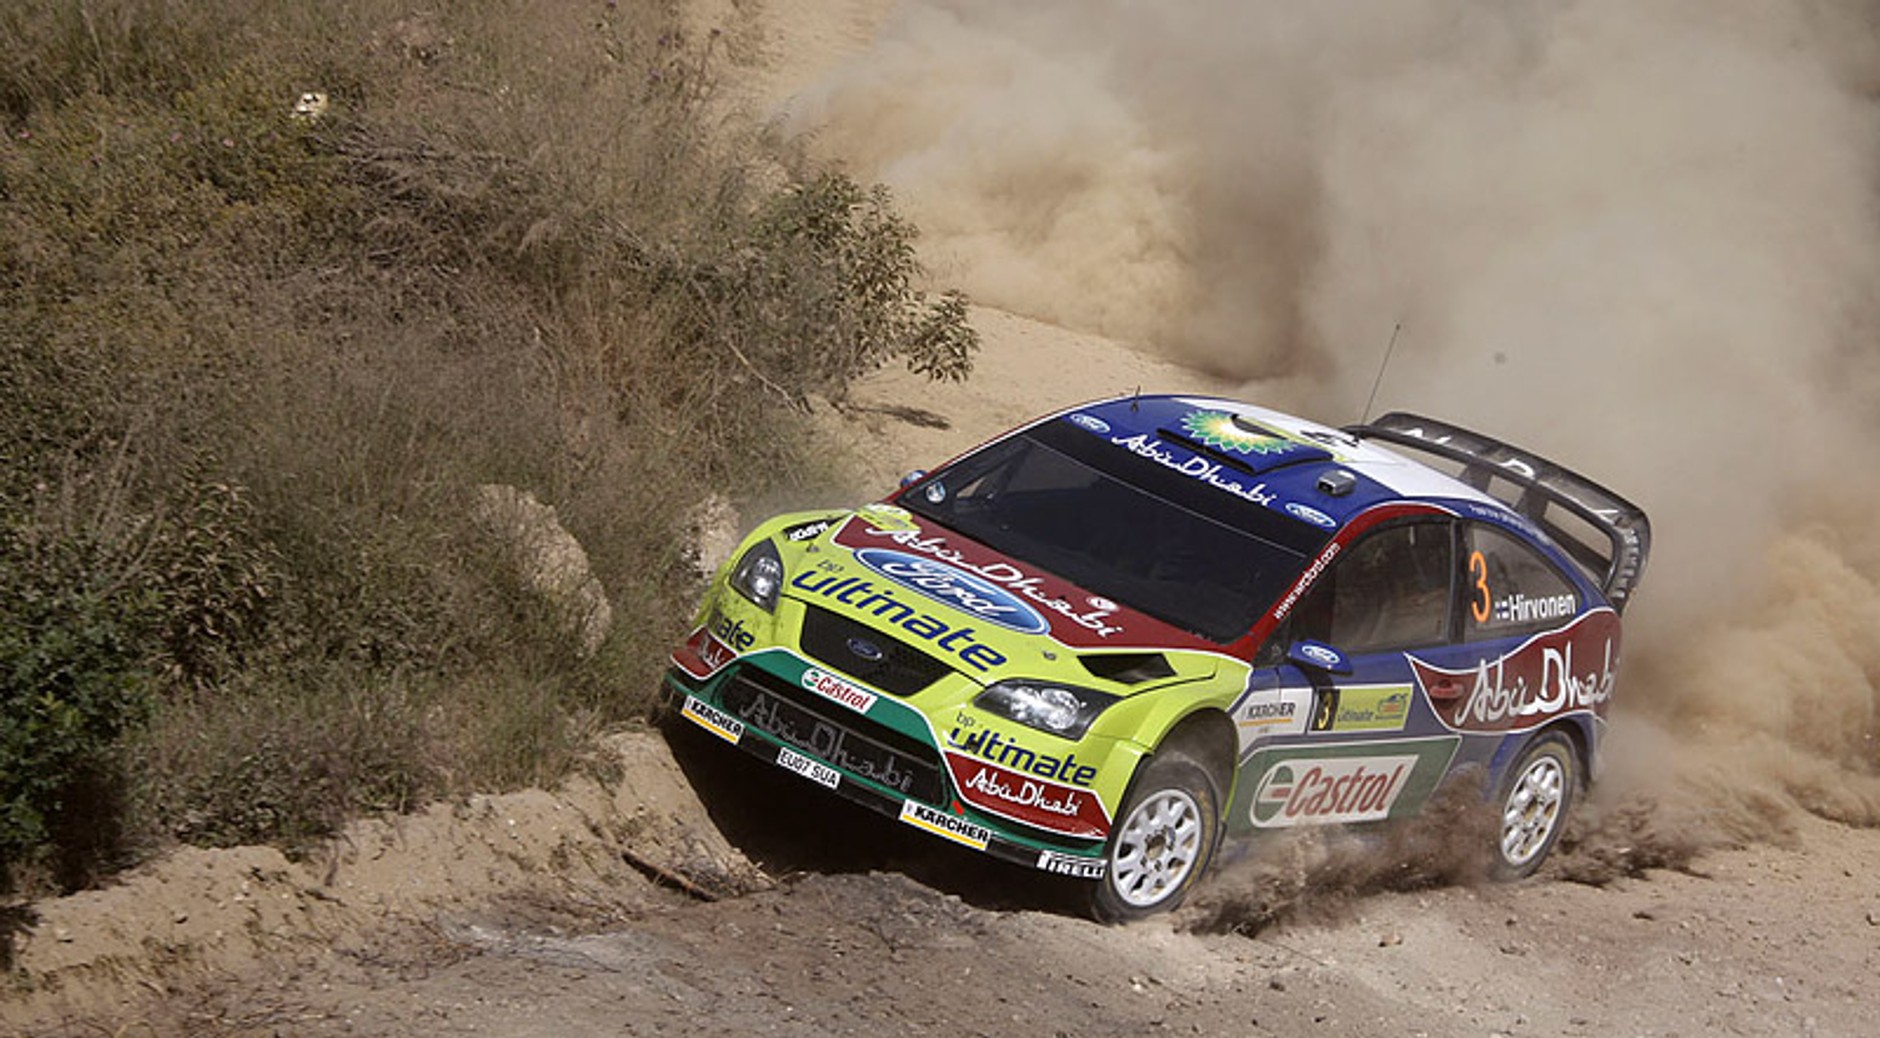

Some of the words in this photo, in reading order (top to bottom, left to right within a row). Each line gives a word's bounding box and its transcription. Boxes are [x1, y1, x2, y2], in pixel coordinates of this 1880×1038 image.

[1112, 435, 1178, 468] Abu
[1180, 459, 1277, 506] Dhabi
[882, 559, 1017, 618] Ford
[978, 563, 1124, 637] Dhabi
[1470, 551, 1491, 622] 3
[1509, 593, 1576, 622] Hirvonen
[792, 570, 1007, 672] ultimate
[817, 676, 871, 711] Castrol
[956, 711, 974, 727] bp
[1455, 654, 1527, 726] Abu
[739, 692, 797, 741] Abu
[810, 719, 917, 793] Dhabi
[780, 750, 811, 772] EU07
[811, 765, 836, 786] SUA
[948, 727, 1097, 786] ultimate
[965, 767, 1011, 802] Abu
[1012, 780, 1083, 817] Dhabi
[1285, 764, 1404, 819] Castrol
[1036, 849, 1108, 880] PIRELLI
